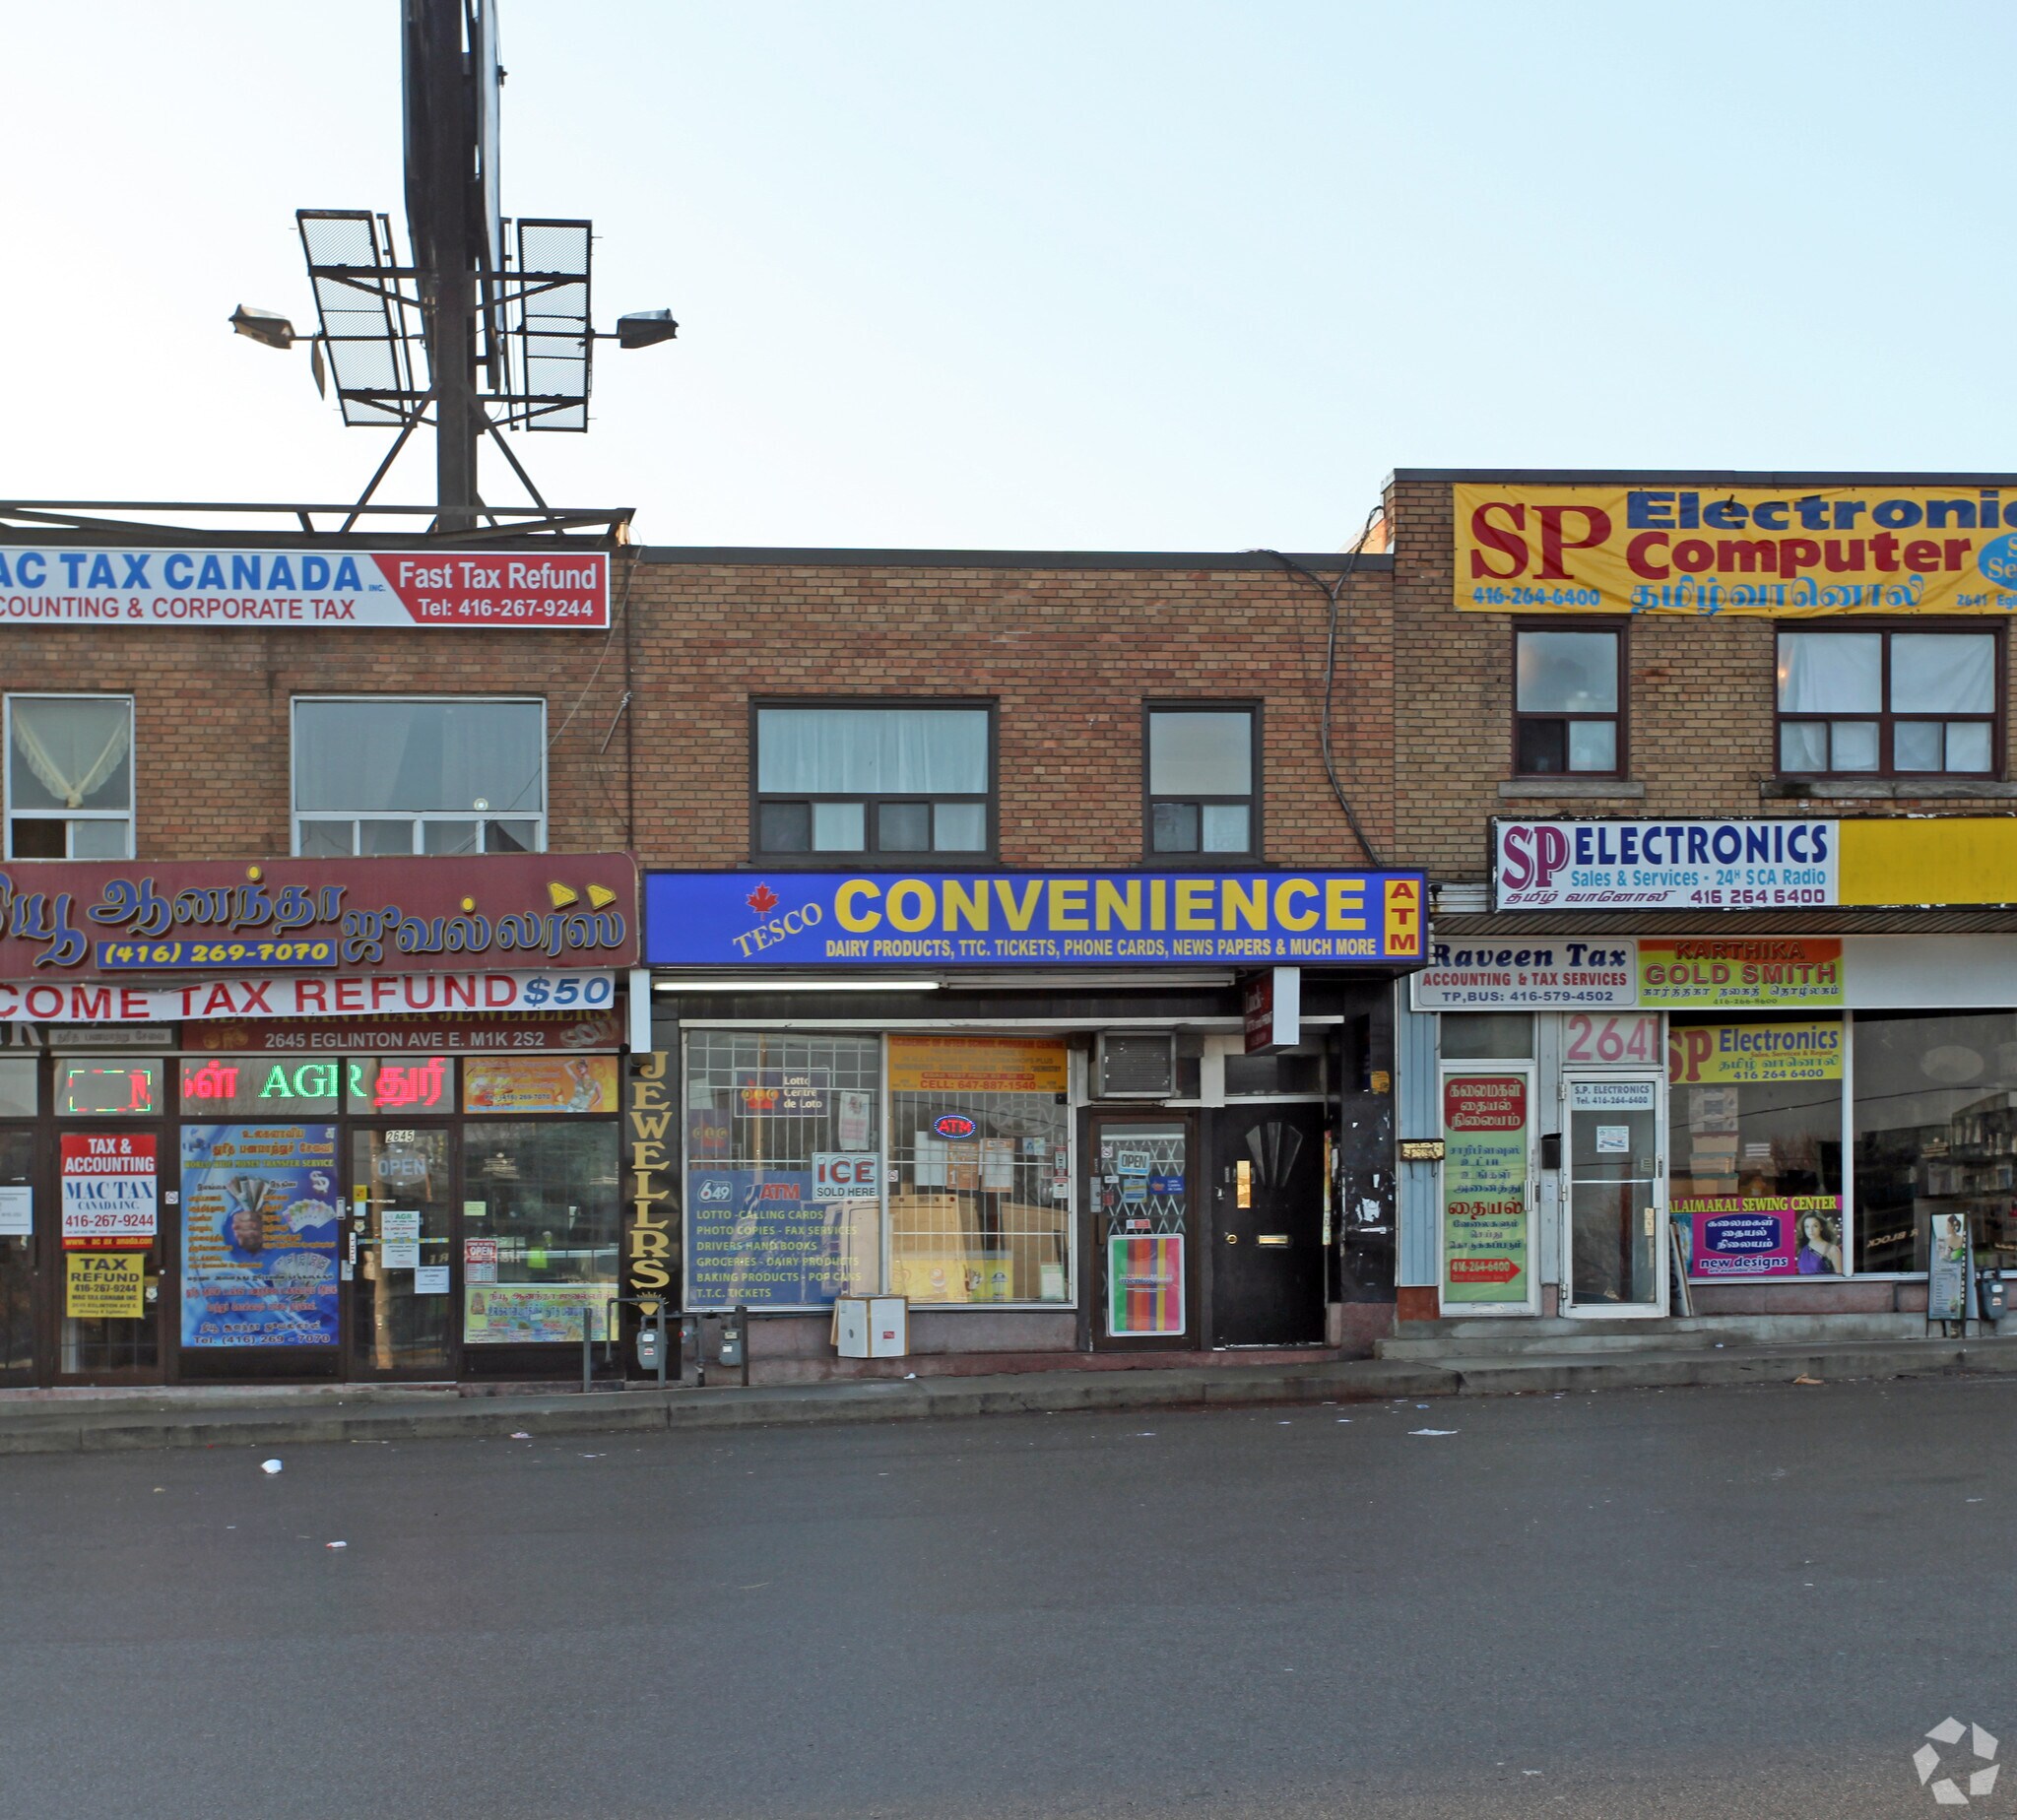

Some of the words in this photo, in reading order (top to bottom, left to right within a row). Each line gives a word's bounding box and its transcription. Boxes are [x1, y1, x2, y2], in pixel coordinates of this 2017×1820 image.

[1470, 502, 1611, 579] SP
[1626, 531, 1972, 579] Computer
[60, 553, 152, 590] TAX
[164, 553, 362, 591] CANADA
[369, 583, 386, 592] INC.
[399, 561, 453, 589] Fast
[458, 562, 501, 589] Tax
[508, 562, 597, 590] Refund
[1472, 587, 1600, 606] 416-264-6400
[127, 597, 144, 618] &
[153, 597, 302, 619] CORPORATE
[310, 599, 356, 619] TAX
[418, 598, 452, 617] Tel:
[458, 599, 593, 618] 416-267-9244
[1502, 825, 1570, 891] SP
[1576, 825, 1828, 865] ELECTRONICS
[1571, 870, 1611, 886] Sales
[1618, 870, 1628, 886] &
[1633, 869, 1698, 886] Services
[1784, 869, 1826, 885] Radio
[1690, 890, 1722, 904] 416
[1730, 890, 1768, 903] 264
[1774, 889, 1825, 903] 6400
[834, 878, 1366, 933] CONVENIENCE
[1390, 882, 1415, 950] ATM
[733, 903, 822, 957] TESCO
[104, 942, 181, 964] (416)
[190, 942, 329, 961] 269-7070
[826, 940, 869, 956] DAIRY
[874, 940, 954, 959] PRODUCTS,
[959, 940, 991, 956] TTC.
[995, 940, 1060, 958] TICKETS,
[1065, 940, 1113, 956] PHONE
[1117, 939, 1169, 958] CARDS,
[1173, 939, 1213, 955] NEWS
[1217, 939, 1269, 955] PAPERS
[1275, 939, 1285, 955] &
[1290, 939, 1332, 955] MUCH
[1336, 939, 1376, 955] MORE
[1434, 943, 1552, 967] Raveen
[1566, 943, 1626, 967] Tax
[1675, 942, 1804, 959] KARTHIKA
[1422, 973, 1511, 986] ACCOUNTING
[1518, 973, 1527, 986] &
[1531, 973, 1558, 986] TAX
[1563, 973, 1627, 986] SERVICES
[1645, 963, 1729, 985] GOLD
[1741, 962, 1836, 984] SMITH
[180, 980, 273, 1016] TAX
[295, 974, 518, 1013] REFUND
[523, 976, 611, 1008] $50
[1442, 992, 1504, 1004] TP,BUS:
[1510, 991, 1613, 1002] 416-579-4502
[266, 1033, 305, 1048] 2645
[311, 1032, 403, 1048] EGLINTON
[410, 1032, 443, 1047] AVE
[449, 1032, 465, 1047] E.
[471, 1032, 508, 1046] M1K
[513, 1032, 545, 1046] 2S2
[1568, 1013, 1658, 1061] 2641
[1720, 1026, 1838, 1052] Electronics
[1790, 1069, 1824, 1077] 6400
[258, 1065, 367, 1098] AGR
[1594, 1085, 1650, 1094] ELECTRONICS
[938, 1120, 972, 1133] ATM
[386, 1132, 414, 1142] 2645
[88, 1138, 116, 1154] TAX
[120, 1138, 132, 1154] &
[64, 1156, 155, 1173] ACCOUNTING
[377, 1160, 426, 1176] OPEN
[817, 1156, 875, 1183] ICE
[1122, 1154, 1147, 1169] OPEN
[66, 1182, 109, 1200] MAC
[113, 1182, 154, 1199] TAX
[759, 1184, 800, 1201] ATM
[816, 1187, 844, 1197] SOLD
[848, 1188, 876, 1197] HERE
[78, 1202, 117, 1210] CANADA
[119, 1202, 140, 1210] INC.
[1742, 1197, 1789, 1211] SEWING
[1790, 1196, 1837, 1210] CENTER
[65, 1214, 154, 1227] 416-267-9244
[696, 1210, 732, 1219] LOTTO
[788, 1210, 823, 1219] CARDS
[696, 1226, 733, 1235] PHOTO
[738, 1226, 775, 1235] COPIES
[785, 1226, 804, 1235] FAX
[808, 1226, 858, 1235] SERVICES
[470, 1247, 492, 1257] OPEN
[696, 1242, 742, 1251] DRIVERS
[746, 1242, 777, 1251] HAND
[780, 1242, 817, 1251] BOOKS
[80, 1259, 128, 1270] TAX
[696, 1258, 756, 1267] GROCERIES
[803, 1258, 859, 1267] PRODUCTS
[1701, 1259, 1730, 1268] new
[1734, 1257, 1788, 1268] designs
[71, 1272, 140, 1282] REFUND
[696, 1272, 738, 1281] BAKING
[742, 1272, 799, 1281] PRODUCTS
[809, 1272, 829, 1281] POP
[696, 1289, 726, 1298] T.T.C.
[728, 1289, 771, 1298] TICKETS
[193, 1335, 217, 1344] Tel.
[223, 1335, 255, 1344] (416)
[261, 1334, 284, 1343] 269
[299, 1334, 331, 1343] 7070
